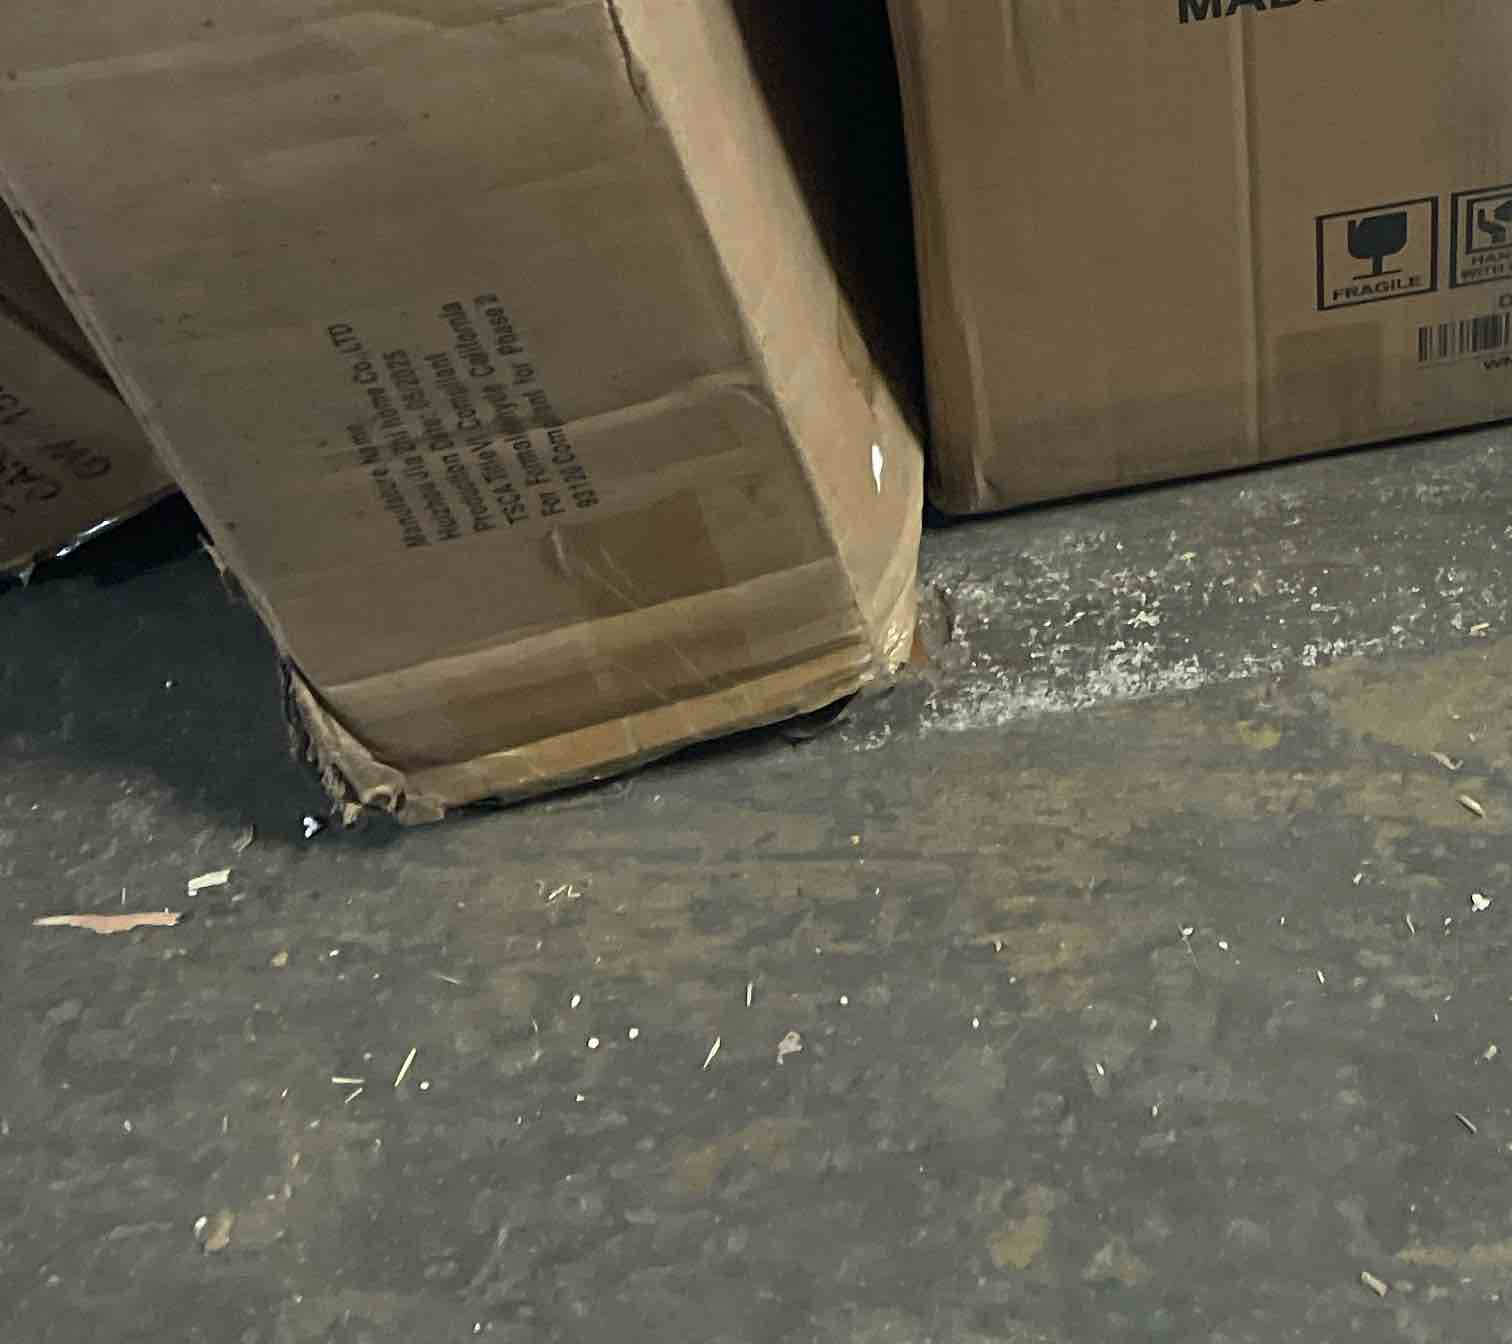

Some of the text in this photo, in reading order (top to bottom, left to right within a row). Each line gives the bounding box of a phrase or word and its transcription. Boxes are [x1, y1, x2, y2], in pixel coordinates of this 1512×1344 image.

[1461, 263, 1505, 282] WITH
[1331, 273, 1423, 302] FRAGILE
[492, 482, 530, 526] TSCA
